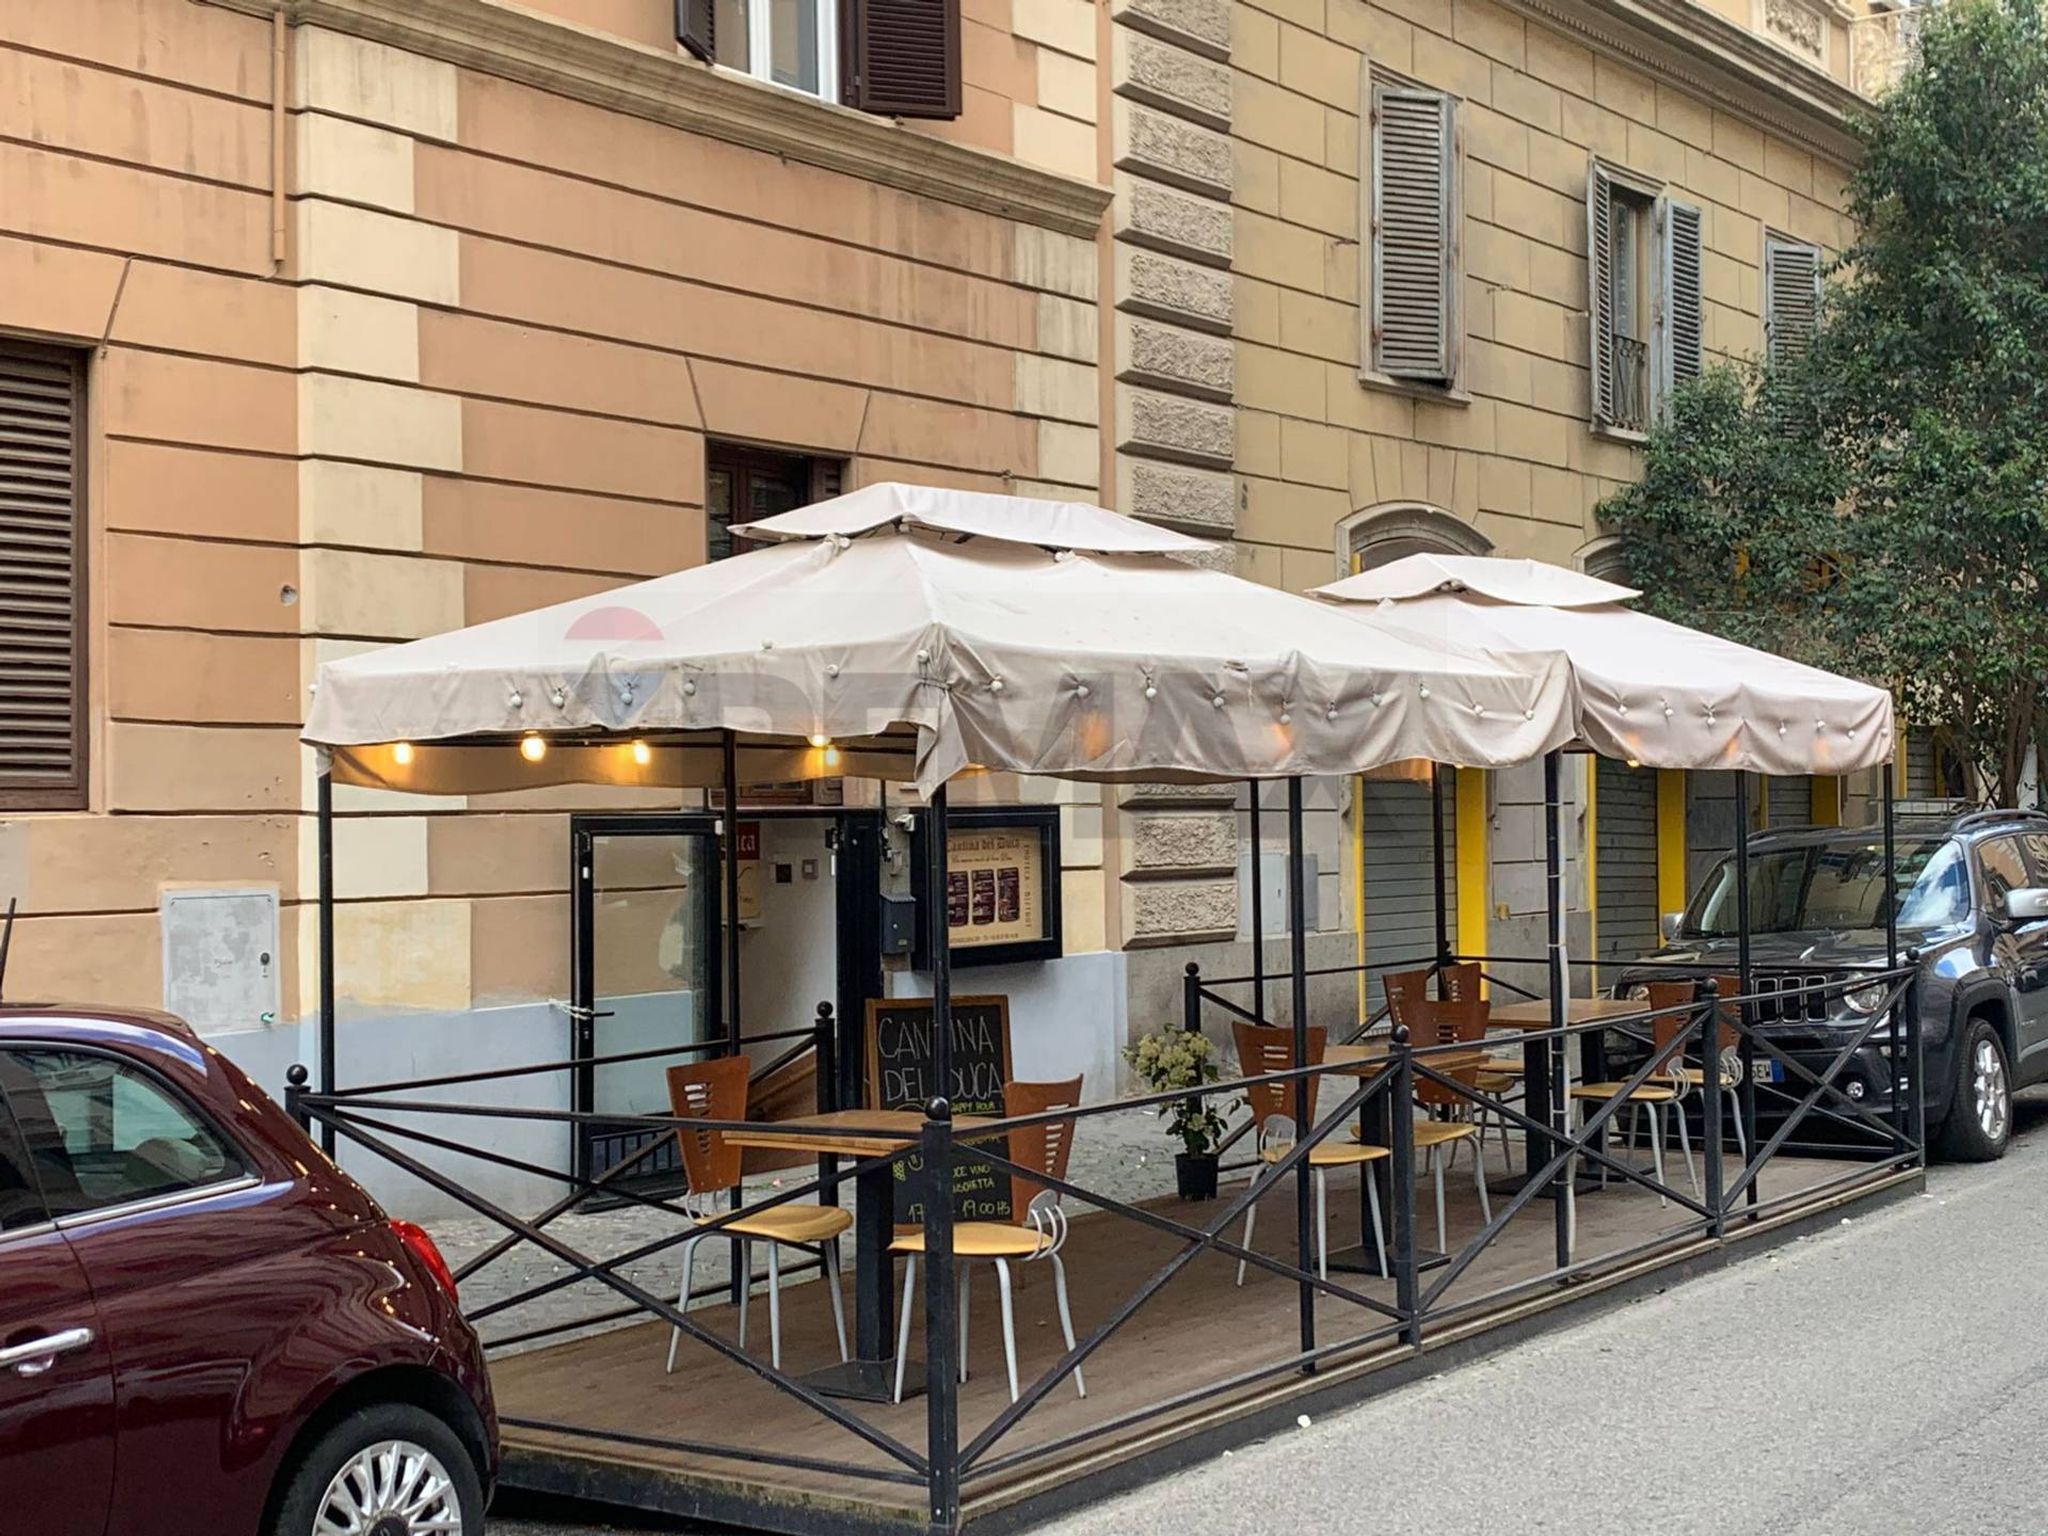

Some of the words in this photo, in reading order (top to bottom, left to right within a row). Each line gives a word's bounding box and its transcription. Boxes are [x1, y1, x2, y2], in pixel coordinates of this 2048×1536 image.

[947, 838, 980, 851] antina
[878, 1016, 995, 1062] CANINA
[885, 1067, 929, 1102] DEL
